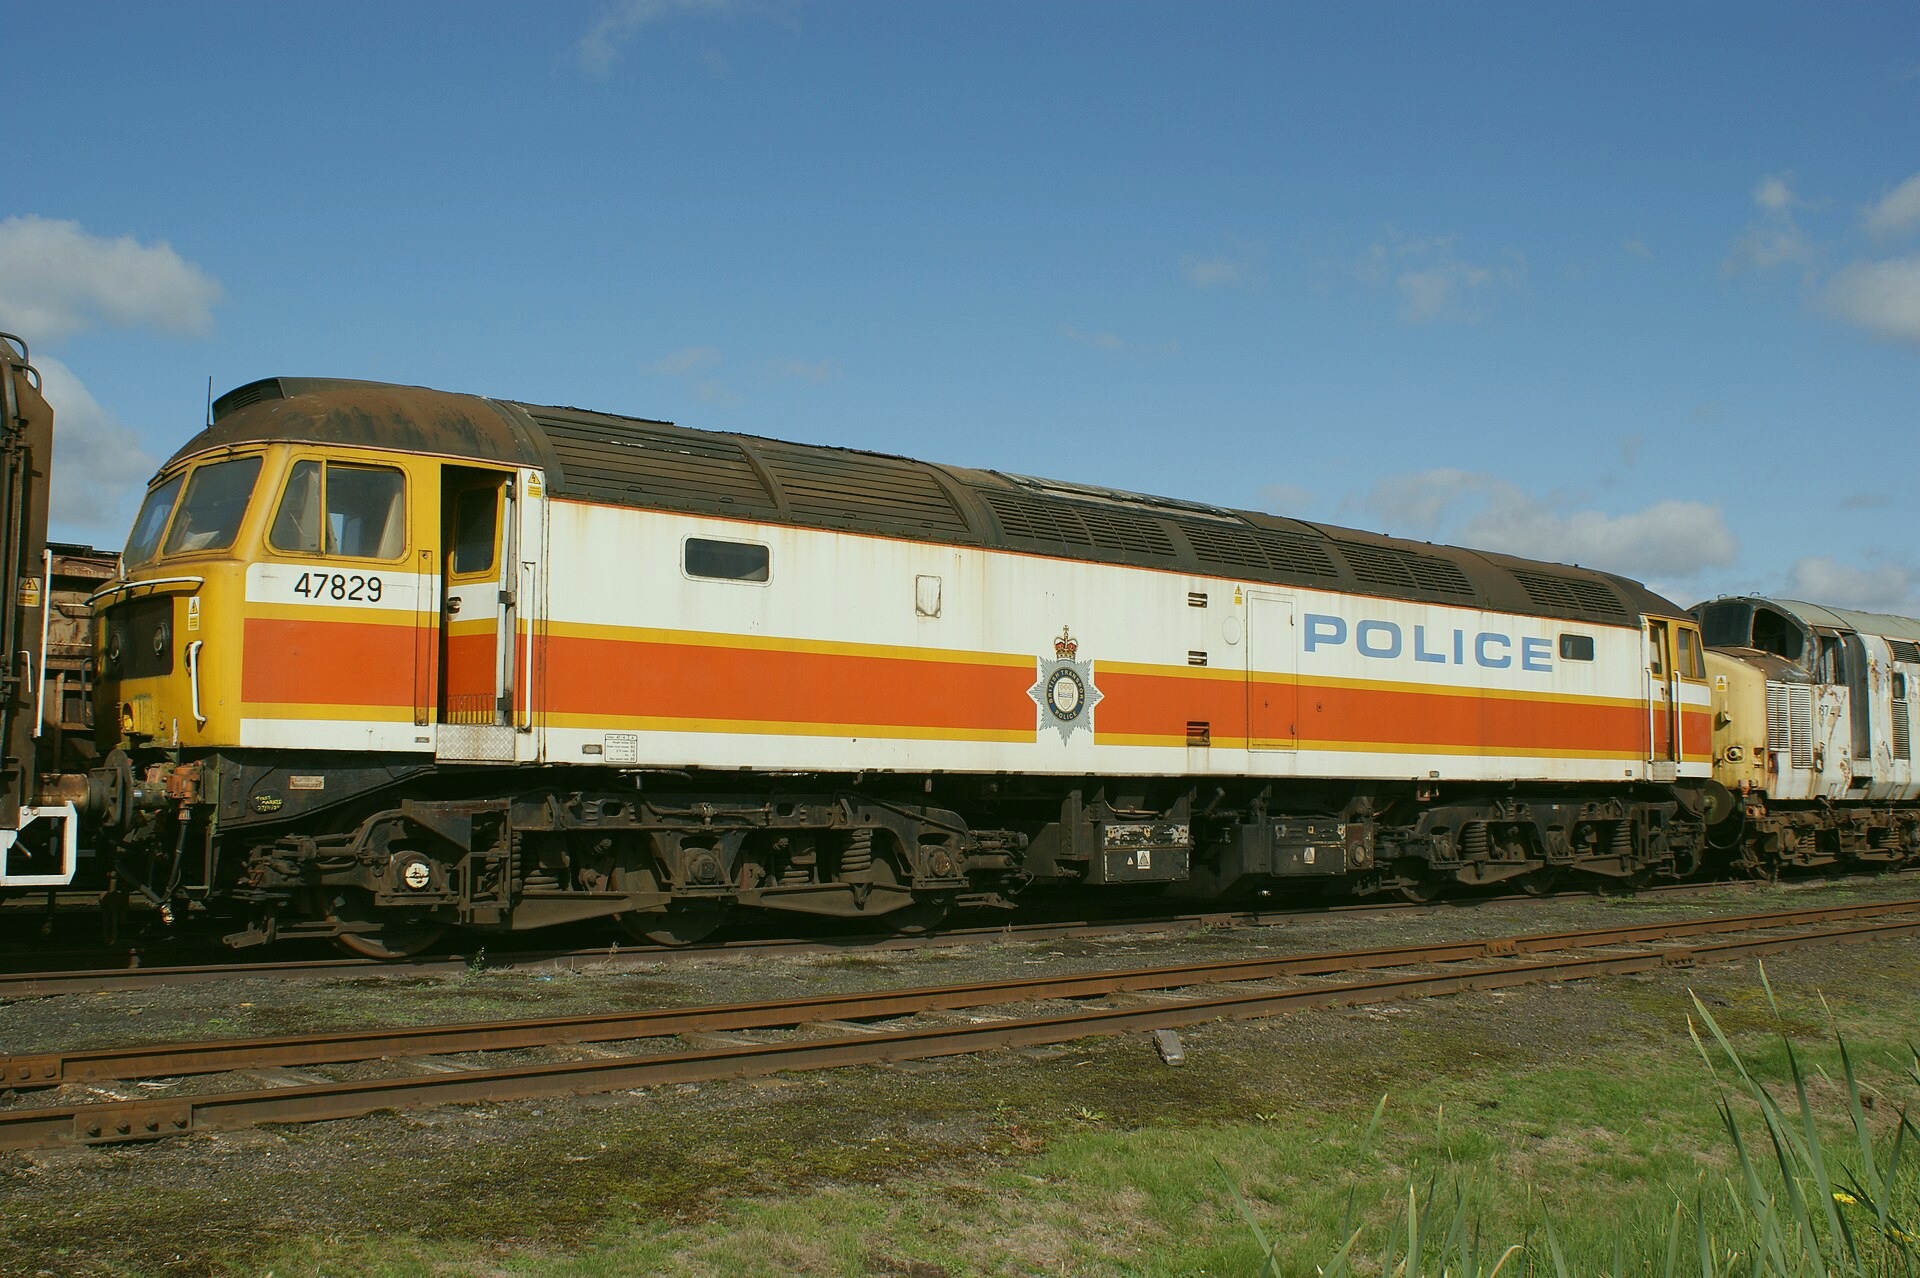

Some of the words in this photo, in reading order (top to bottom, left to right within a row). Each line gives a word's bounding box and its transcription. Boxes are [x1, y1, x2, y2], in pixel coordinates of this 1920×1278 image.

[294, 572, 382, 602] 47829
[1304, 613, 1553, 672] POLICE
[1048, 672, 1060, 704] BRITISH
[1061, 670, 1084, 705] TRANSPORT
[1055, 710, 1077, 720] POLICE
